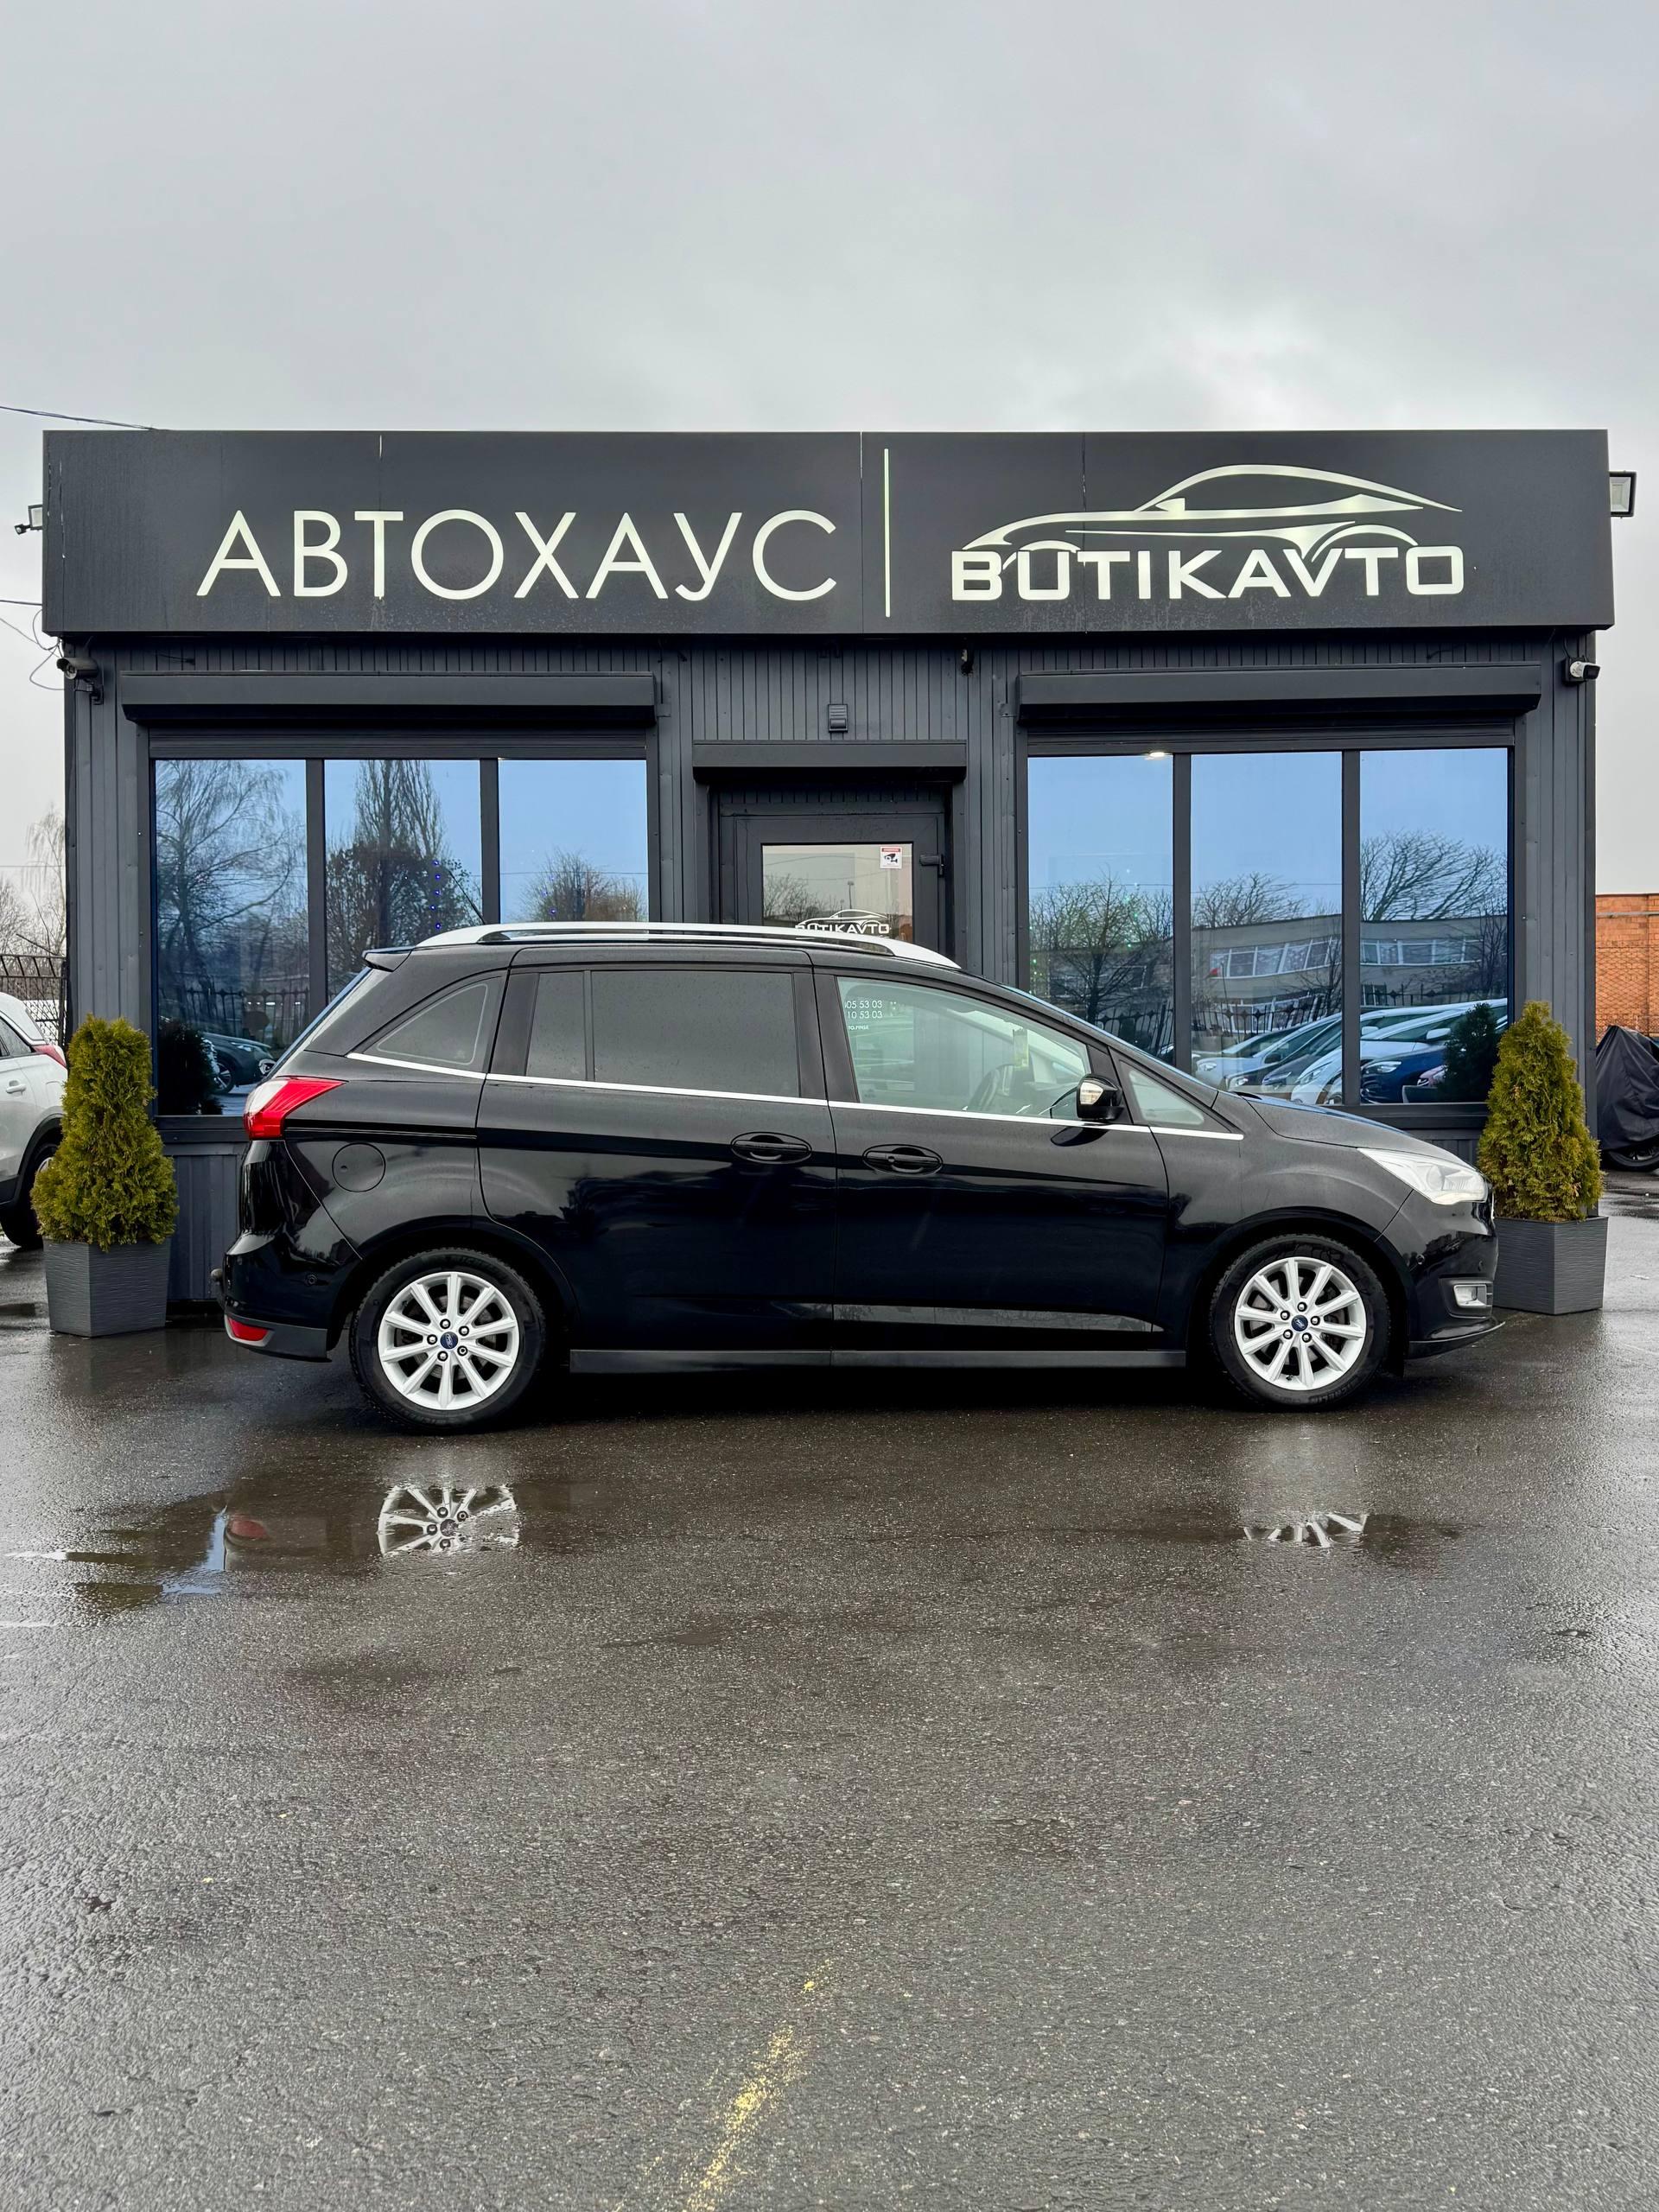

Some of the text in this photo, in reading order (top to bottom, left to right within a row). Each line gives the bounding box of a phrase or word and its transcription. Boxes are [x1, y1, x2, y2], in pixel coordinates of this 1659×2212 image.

[196, 509, 837, 601] АВТОХАУС
[951, 546, 1465, 601] BUTIKAVTO
[844, 1000, 882, 1009] 05 53 03
[859, 1010, 869, 1019] 53
